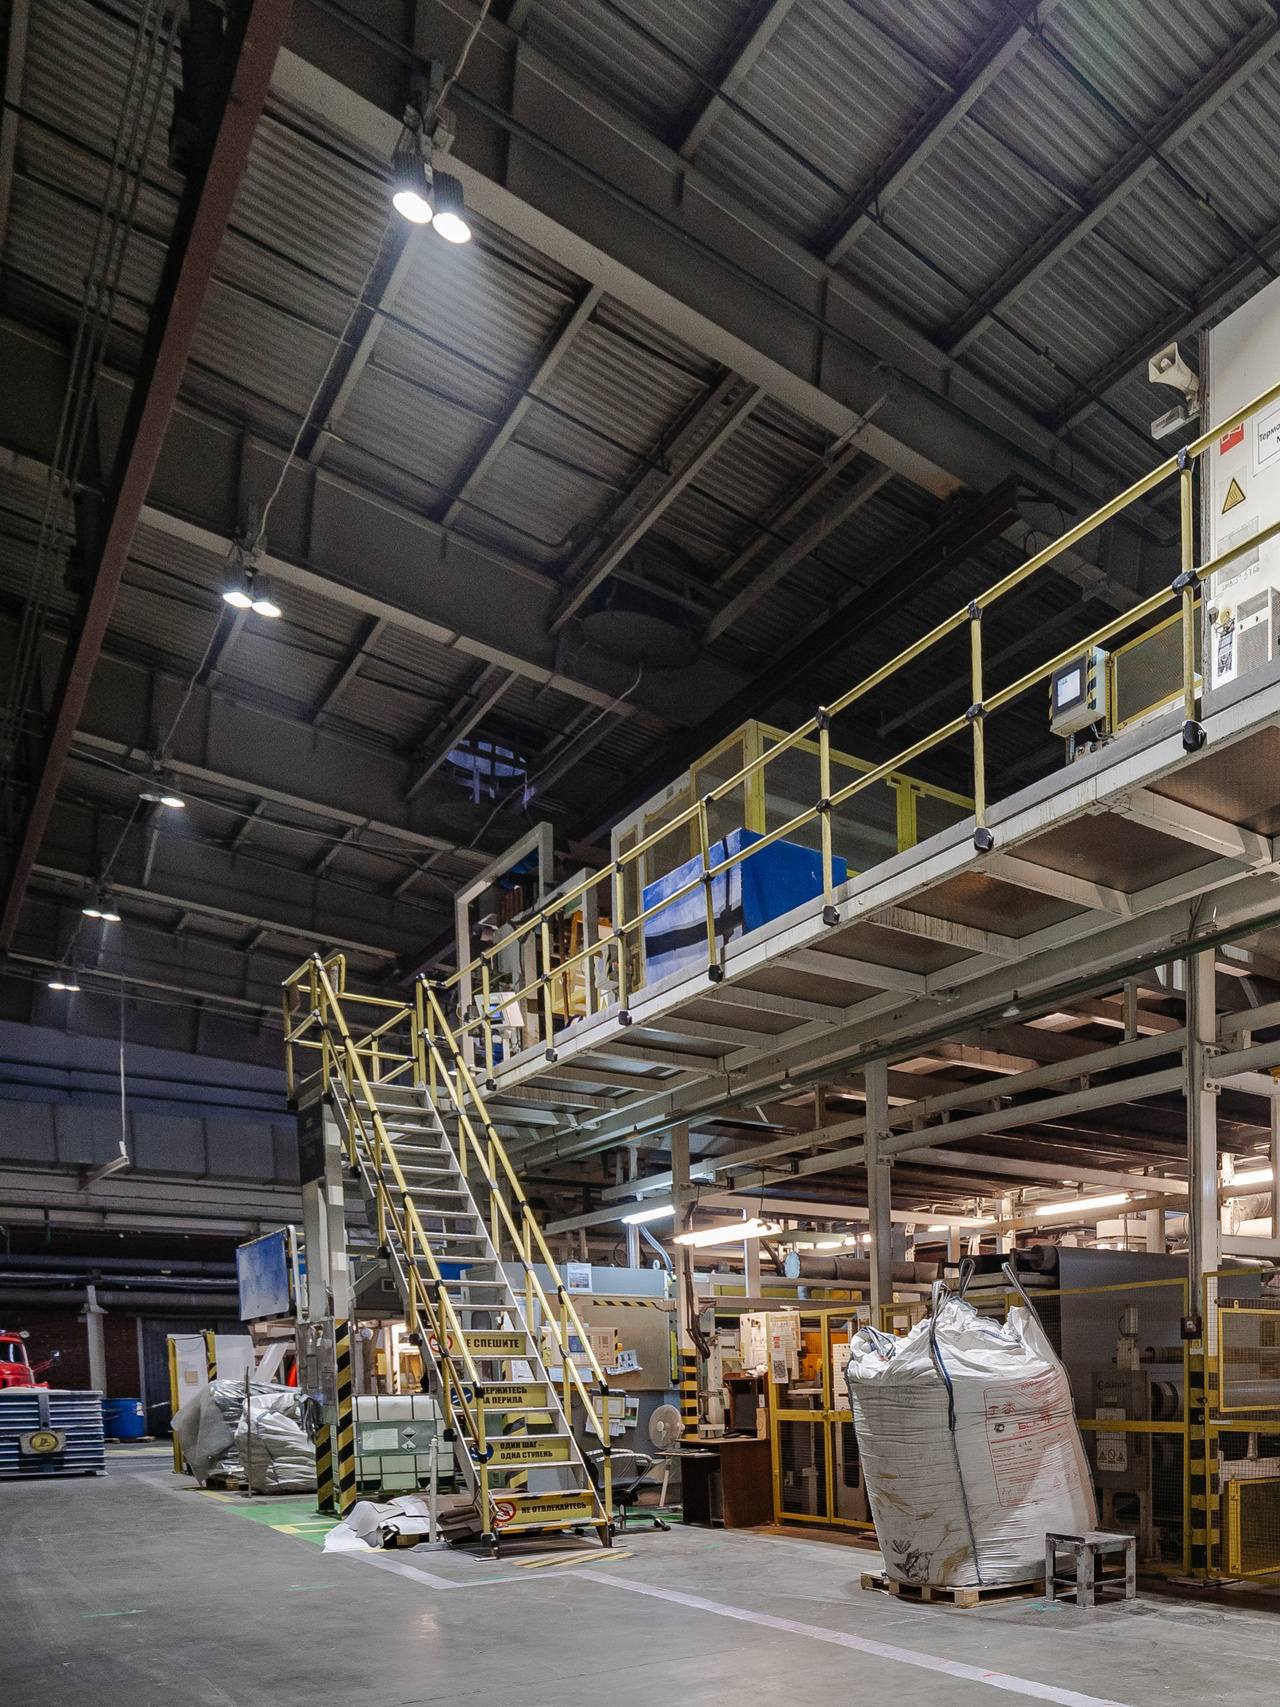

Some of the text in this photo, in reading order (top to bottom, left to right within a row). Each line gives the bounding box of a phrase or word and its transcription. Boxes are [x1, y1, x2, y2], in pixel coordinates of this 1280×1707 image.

[473, 1339, 519, 1348] СПЕШИТЕ
[492, 1396, 523, 1404] ПЕРИЛА
[500, 1442, 520, 1450] ОДИН
[500, 1451, 553, 1460] ОДНА СТУПЕНЬ
[521, 1502, 586, 1514] НЕ ОТВЛЕКАЙТЕСЬ
